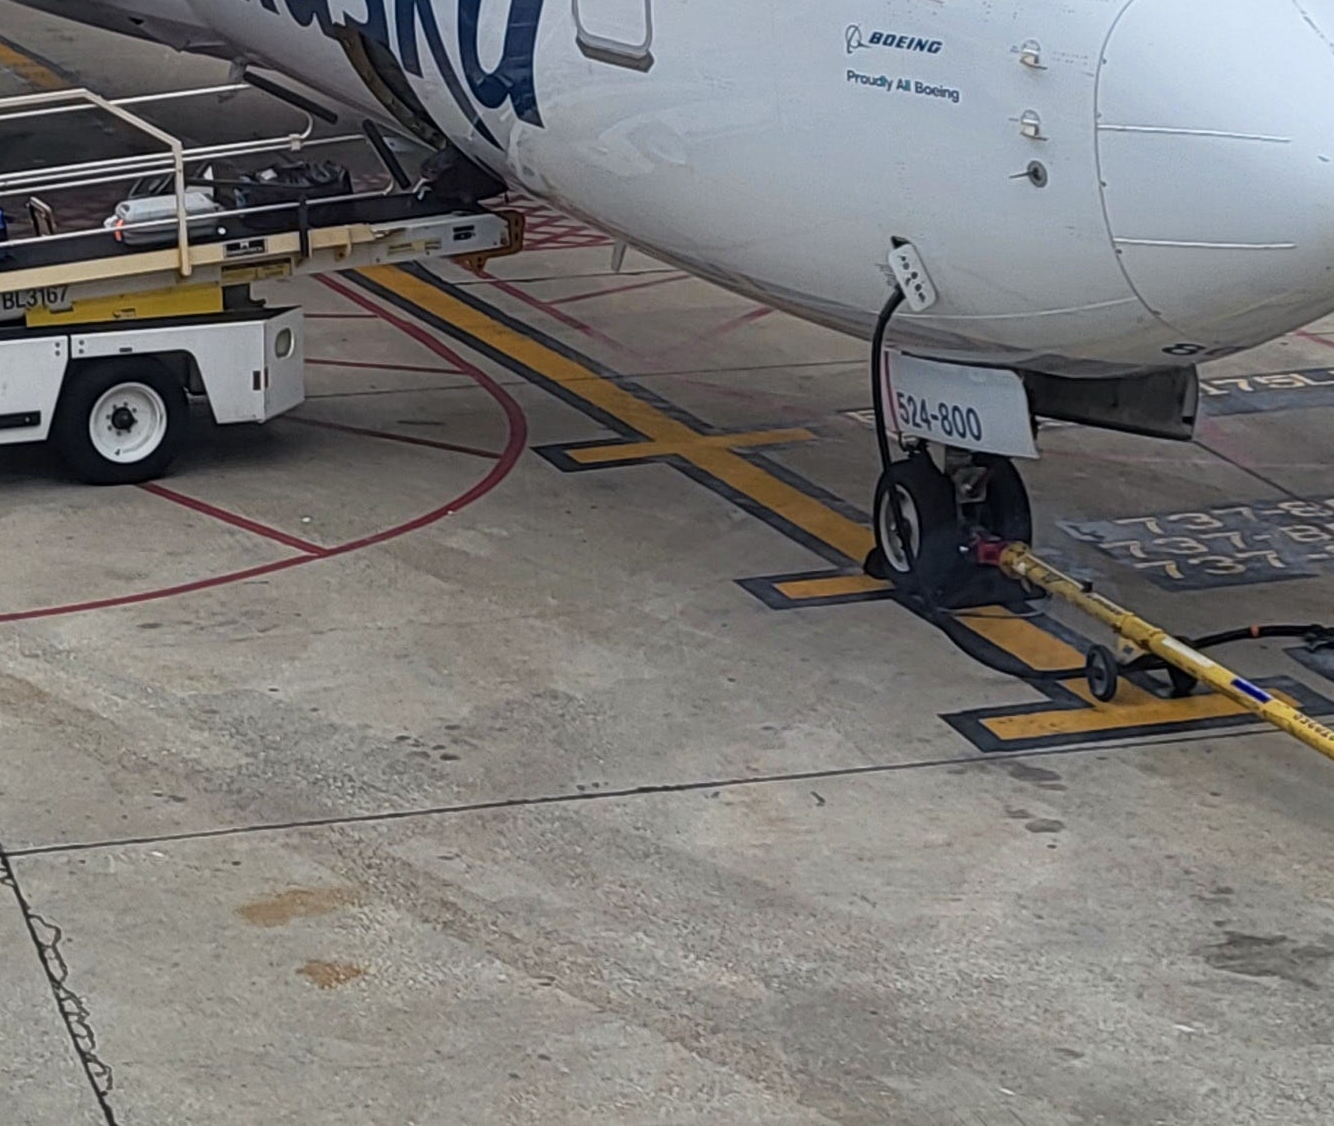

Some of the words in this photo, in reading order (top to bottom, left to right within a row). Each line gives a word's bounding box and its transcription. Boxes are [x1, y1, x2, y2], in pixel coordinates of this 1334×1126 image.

[868, 31, 943, 54] BOEING
[847, 69, 894, 92] Proudly
[896, 78, 911, 92] All
[914, 80, 960, 103] Boeing
[2, 283, 68, 310] BL3167
[896, 391, 983, 442] 524-800
